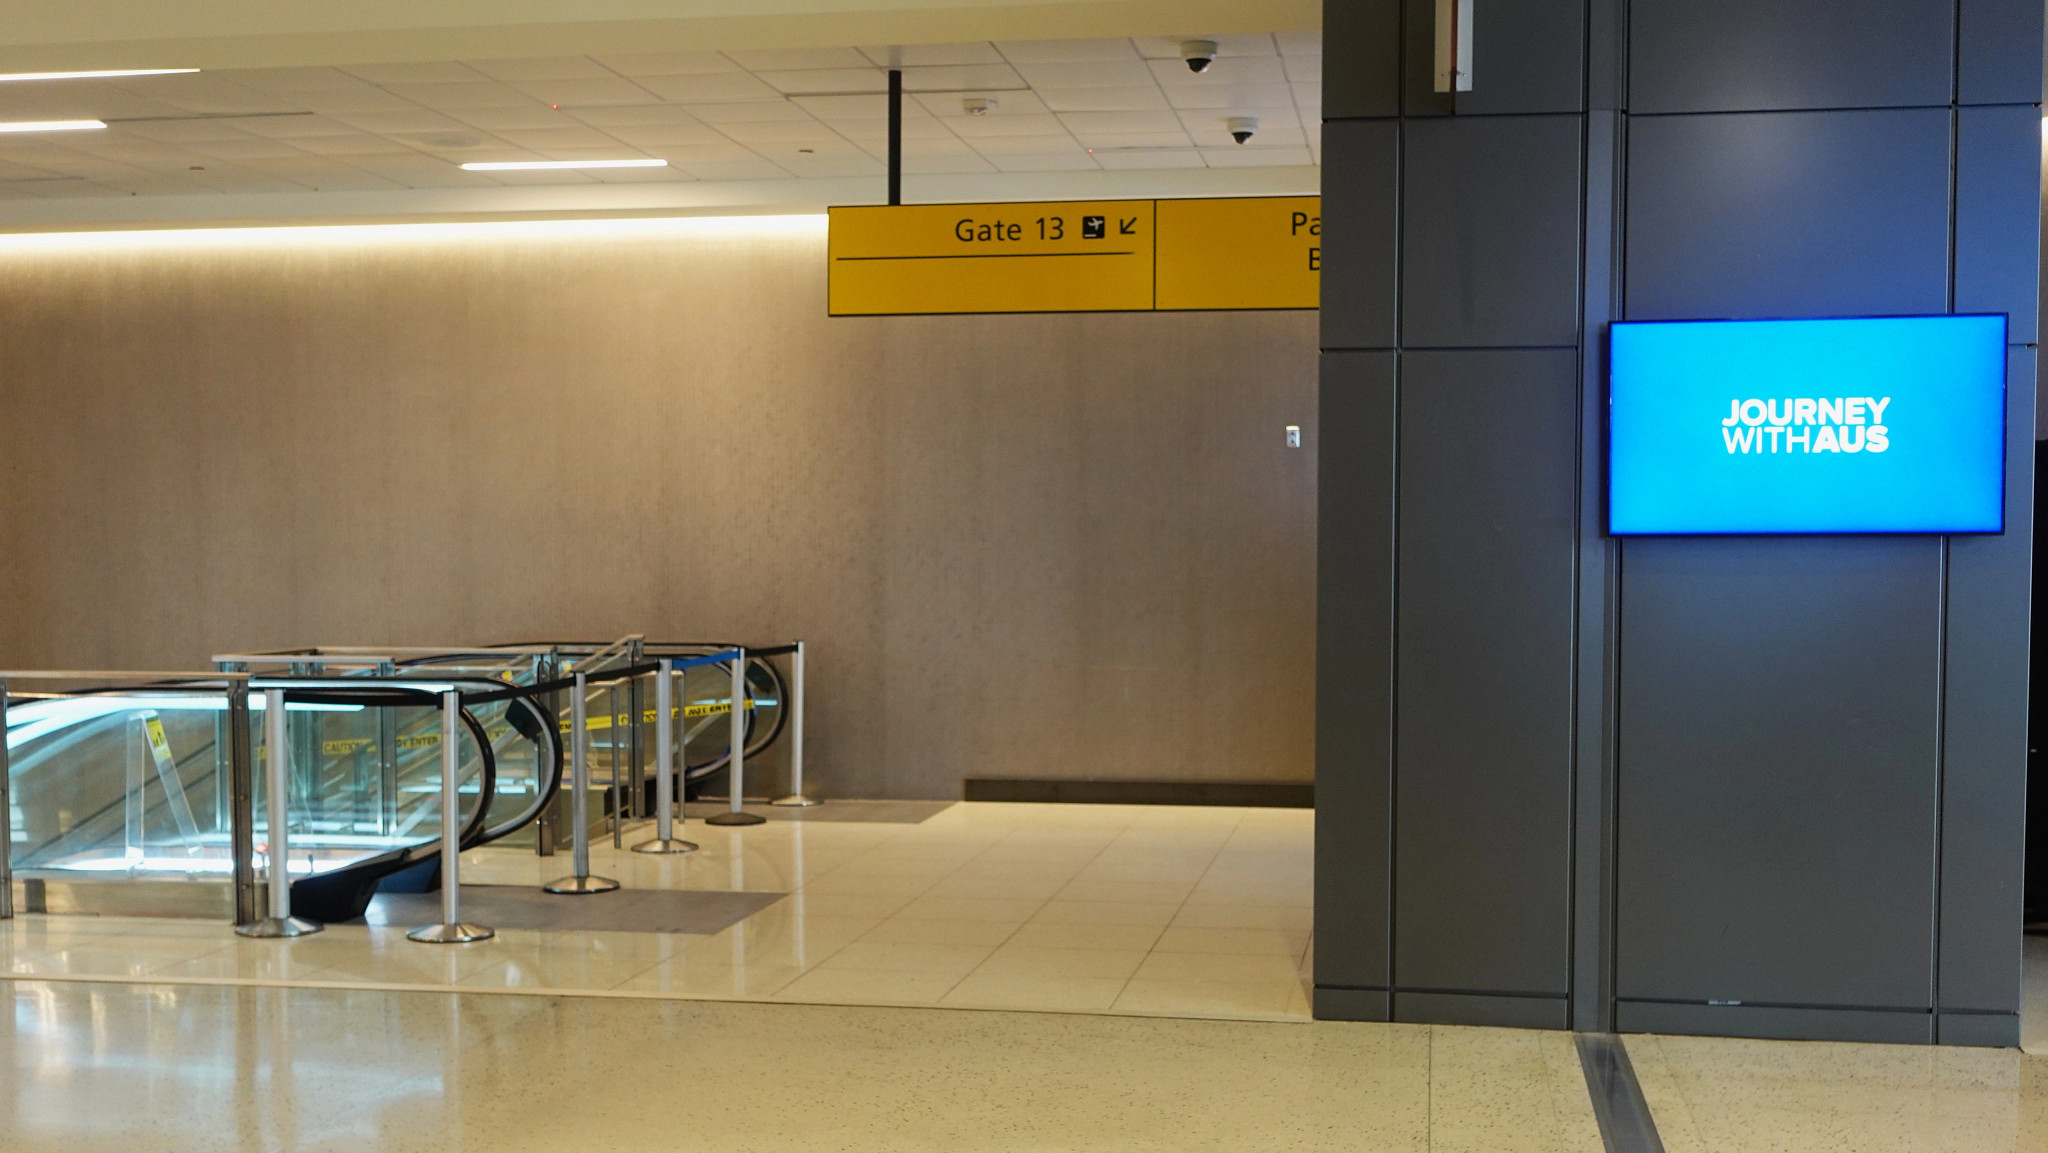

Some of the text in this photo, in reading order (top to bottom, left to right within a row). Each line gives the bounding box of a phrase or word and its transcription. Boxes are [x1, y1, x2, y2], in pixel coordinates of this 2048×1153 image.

[955, 216, 1064, 242] Gate 13
[1721, 396, 1891, 427] JOURNEY
